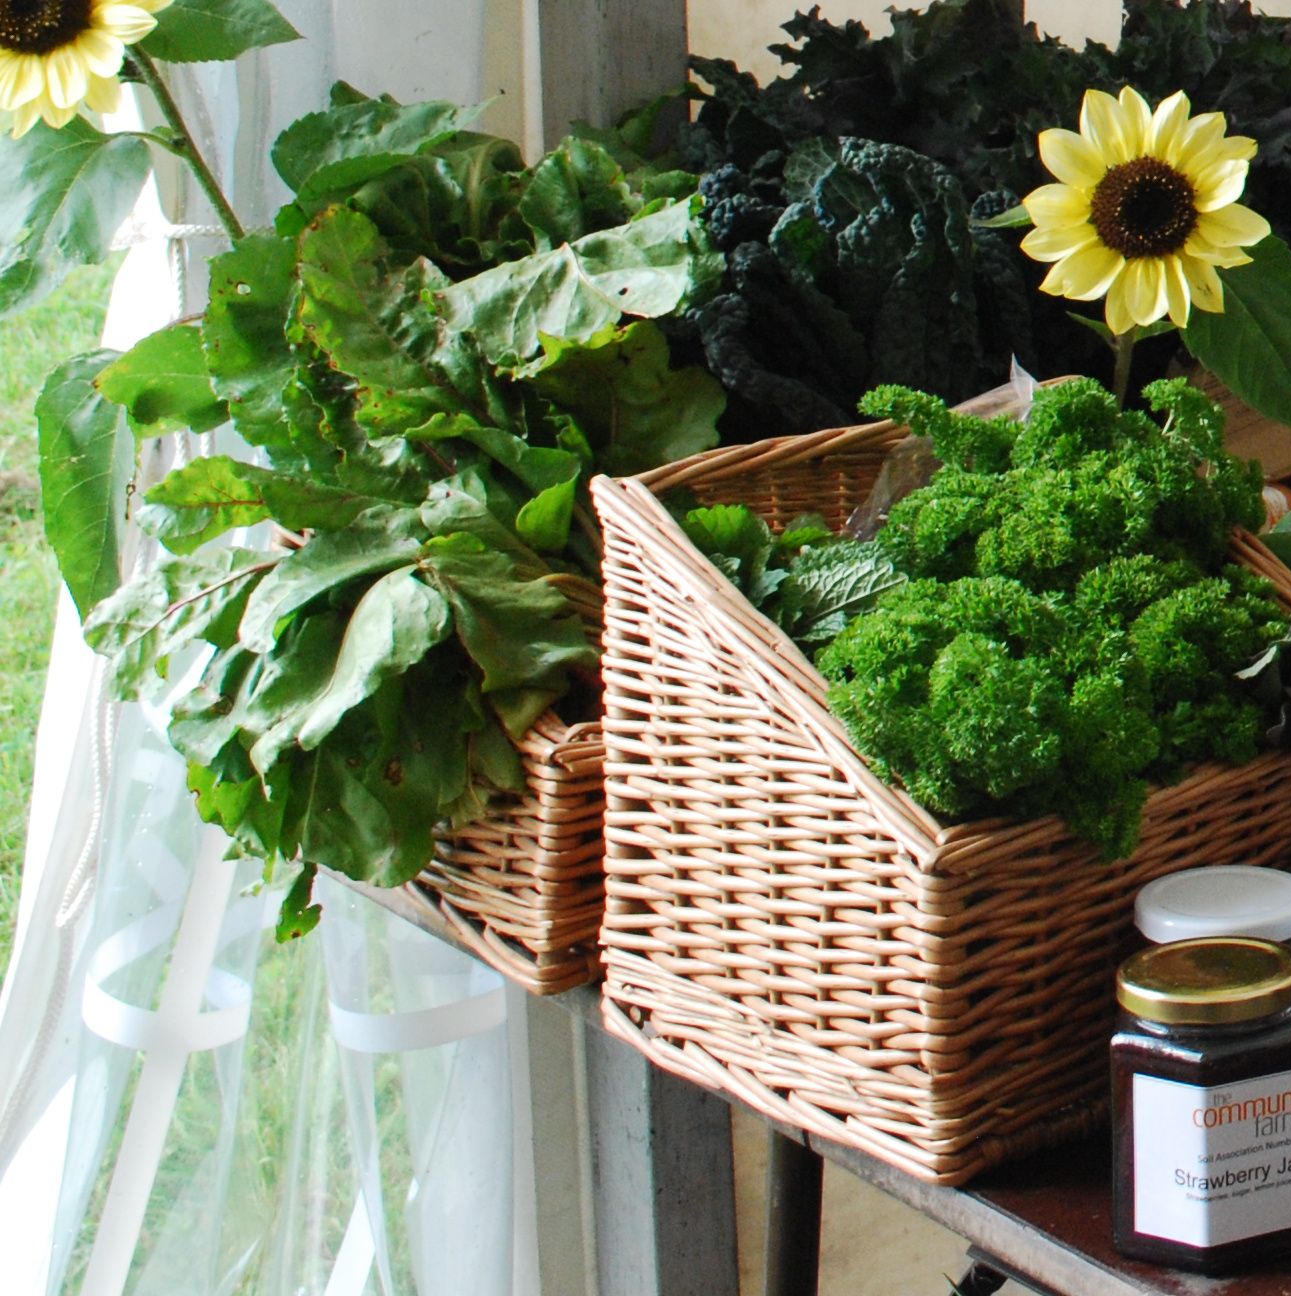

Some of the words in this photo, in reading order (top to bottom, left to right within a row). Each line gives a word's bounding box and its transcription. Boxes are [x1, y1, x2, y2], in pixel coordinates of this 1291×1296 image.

[1213, 1092, 1233, 1106] the
[1215, 1145, 1264, 1162] Association
[1174, 1164, 1272, 1191] Strawberry
